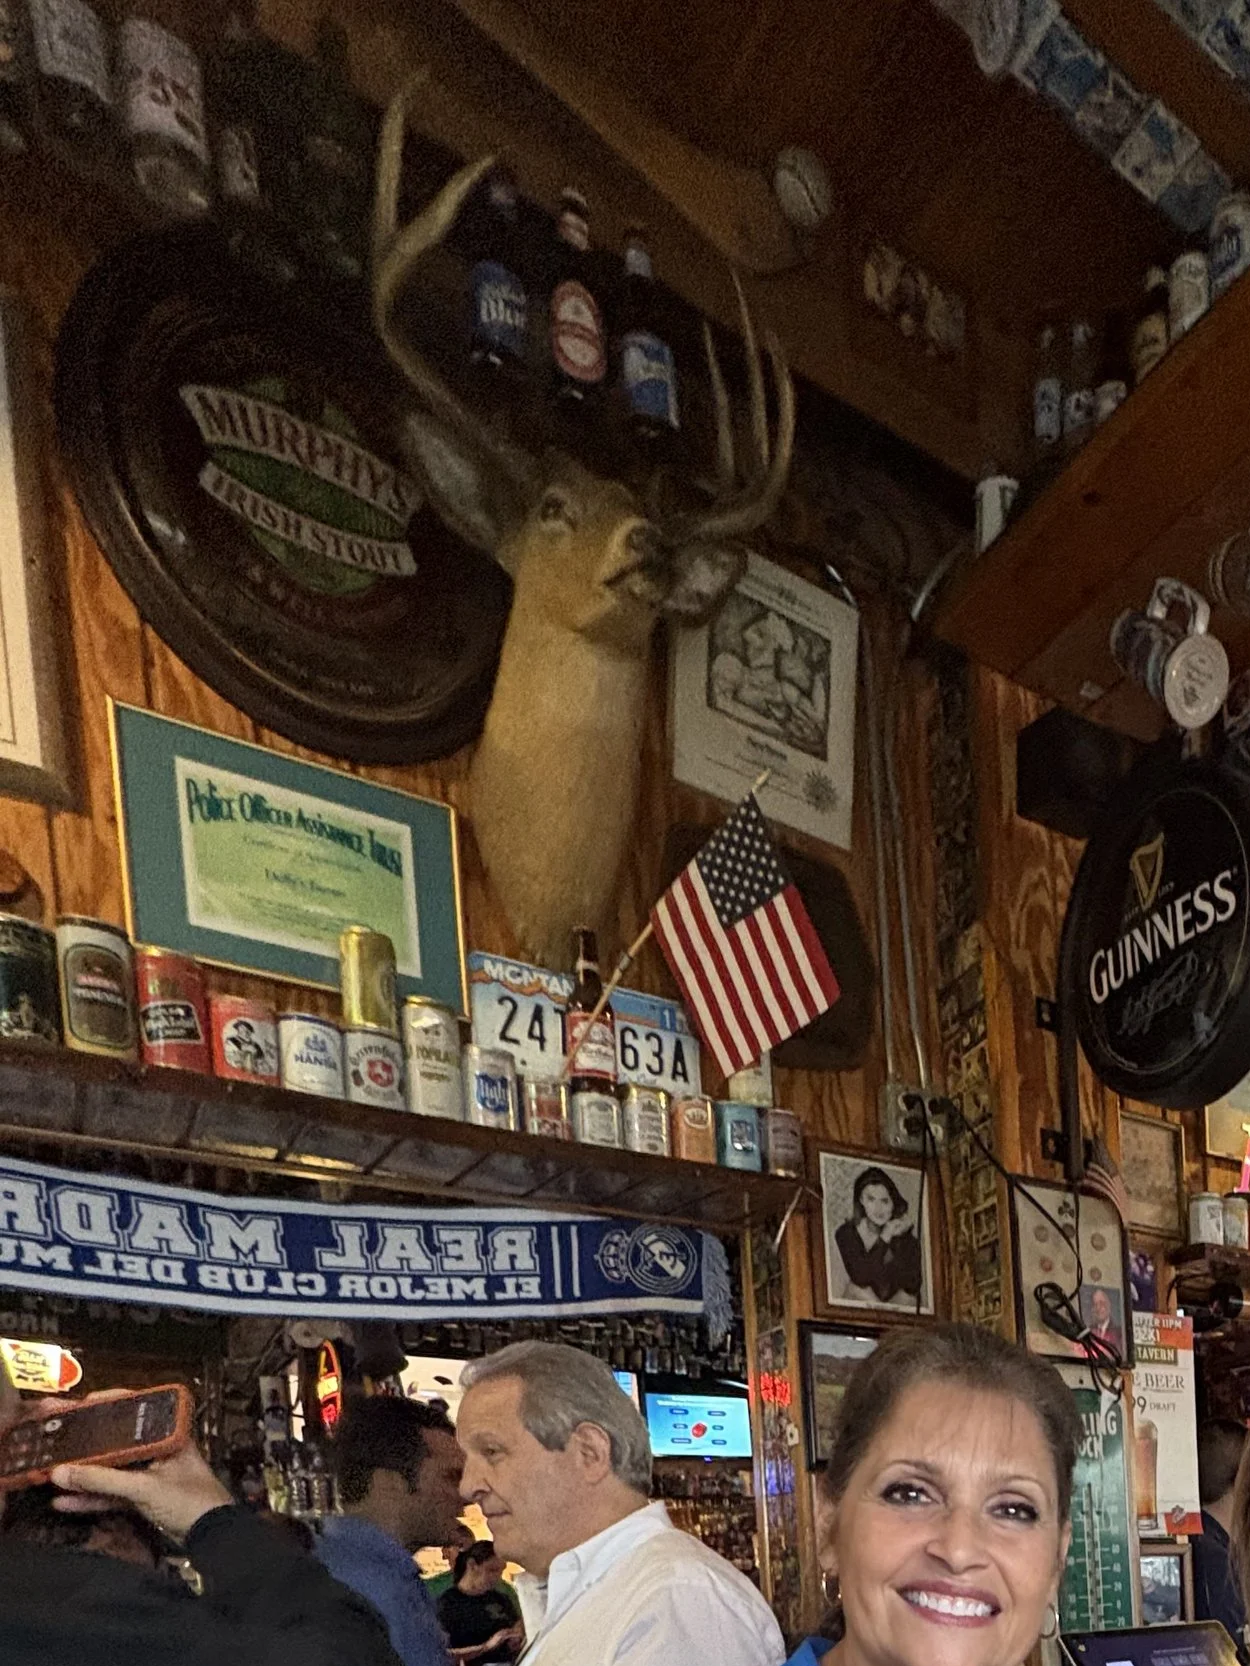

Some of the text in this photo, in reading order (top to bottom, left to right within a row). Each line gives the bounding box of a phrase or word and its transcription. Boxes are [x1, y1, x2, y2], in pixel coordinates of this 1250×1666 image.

[193, 391, 411, 512] MURPHY'S
[212, 472, 404, 573] IRISH STOUT
[1090, 868, 1237, 1005] GUINNESS
[483, 960, 575, 996] MONTAN
[620, 1026, 690, 1084] 63A
[1137, 1347, 1175, 1362] TAVERN
[1144, 1372, 1185, 1389] BEER
[1149, 1402, 1177, 1413] DRAFT
